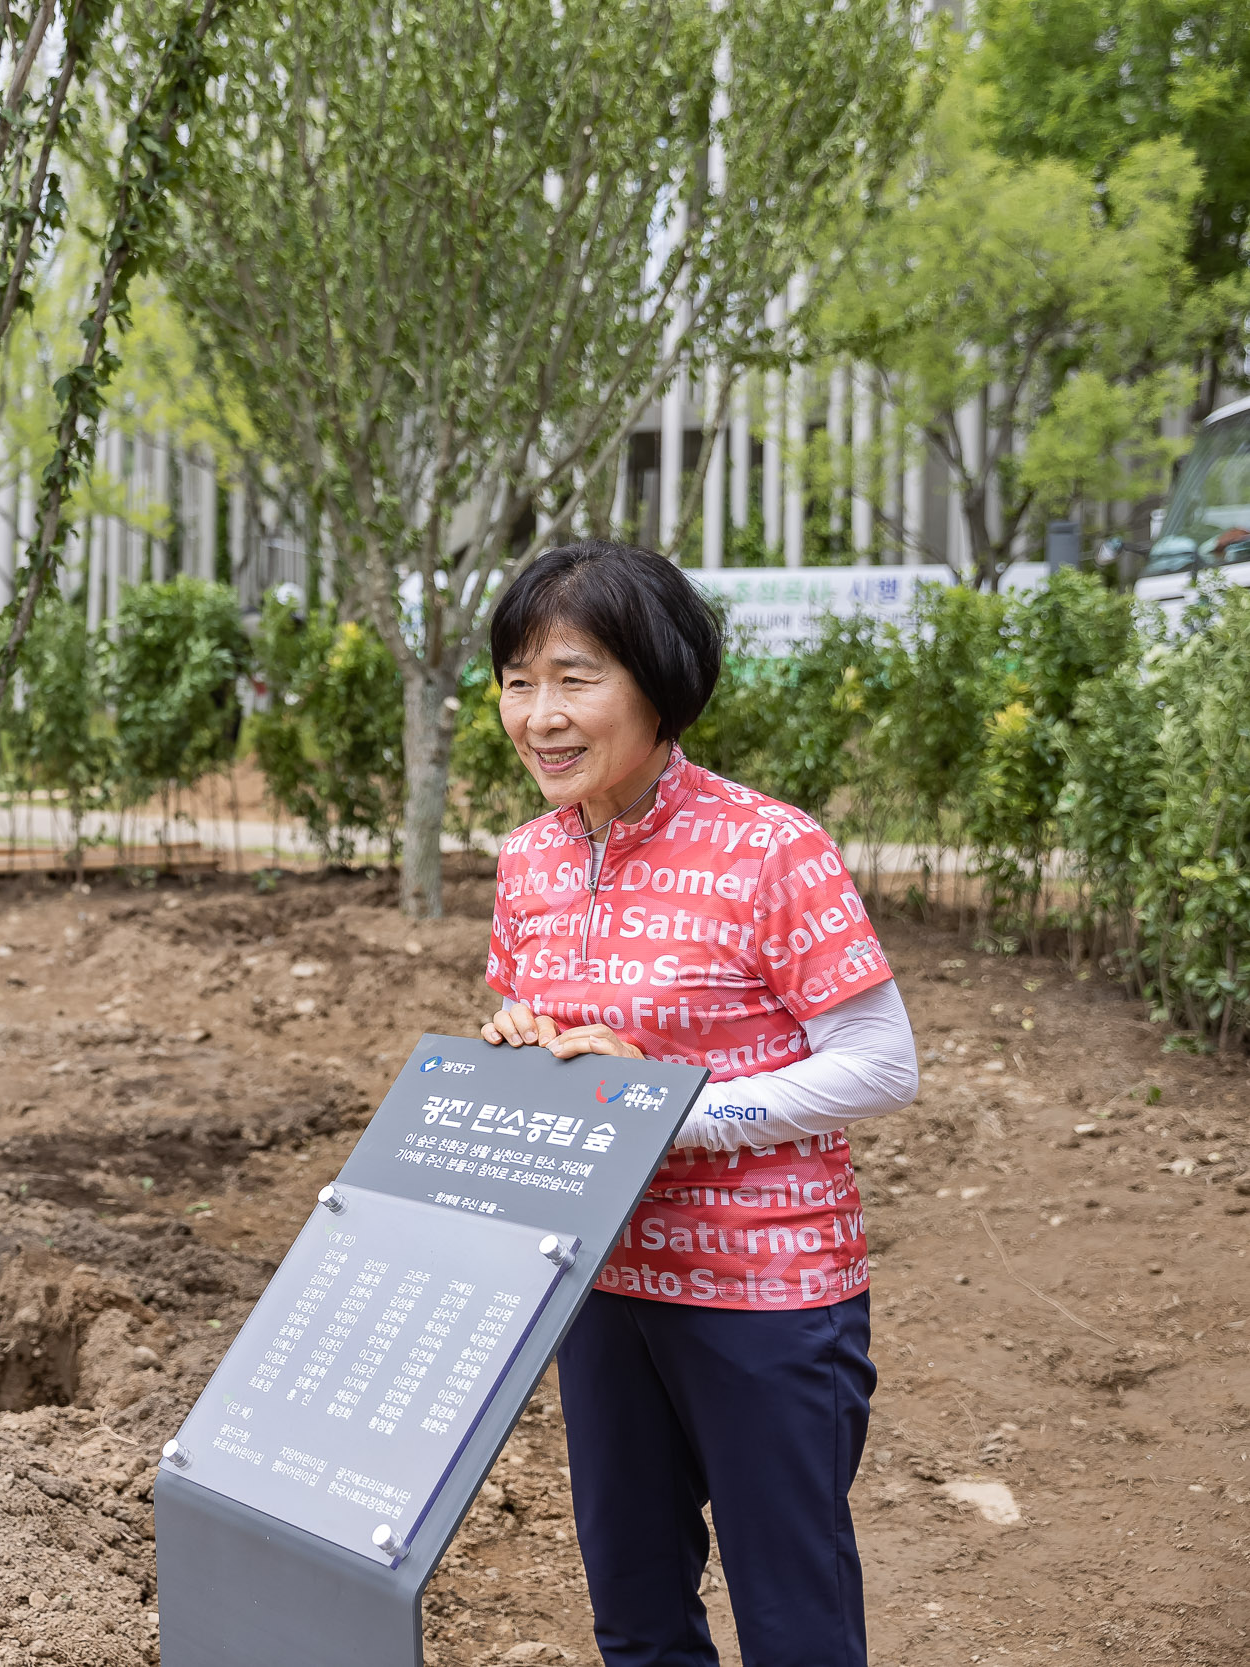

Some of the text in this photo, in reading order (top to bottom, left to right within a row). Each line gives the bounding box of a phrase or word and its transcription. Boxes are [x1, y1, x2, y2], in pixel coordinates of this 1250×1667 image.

[761, 906, 850, 970] Sole
[529, 948, 645, 985] Sabato
[631, 996, 750, 1036] Friya
[441, 1060, 476, 1075] 광진구
[421, 1095, 617, 1153] 광진 탄소중립 숲
[395, 1148, 586, 1196] 기여해 주신 분들의 참여로 조성되었습니다.
[404, 1132, 595, 1178] 이 숲은 친환경 생활 실천으로 탄소 저감에
[434, 1191, 462, 1207] 함께해
[460, 1197, 480, 1211] 주신
[477, 1200, 498, 1215] 분들
[641, 1217, 822, 1254] Saturno
[363, 1258, 391, 1275] 강선임
[403, 1269, 432, 1285] 고은주
[689, 1268, 788, 1304] Sole
[301, 1286, 327, 1302] 김영자
[340, 1297, 367, 1313] 김진아
[381, 1308, 408, 1325] 김현옥
[469, 1332, 498, 1351] 박경현
[309, 1274, 507, 1337] 김미나 김병숙 김성동 김수진 김여진
[439, 1293, 469, 1310] 김기정
[484, 1305, 515, 1322] 김다영
[295, 1299, 320, 1315] 박영신
[333, 1310, 359, 1327] 박정아
[415, 1334, 443, 1352] 서미숙
[460, 1346, 490, 1365] 송선아
[324, 1323, 352, 1340] 오정석
[264, 1350, 289, 1366] 이정표
[318, 1336, 345, 1353] 이경진
[358, 1348, 386, 1366] 이그림
[256, 1362, 282, 1380] 정인성
[310, 1349, 337, 1366] 이유정
[350, 1362, 378, 1379] 이유진
[393, 1375, 421, 1393] 이은영
[219, 1423, 252, 1444] 광진구청
[278, 1446, 328, 1473] 자양어린이집
[326, 1480, 404, 1520] 한국사회보장정보원
